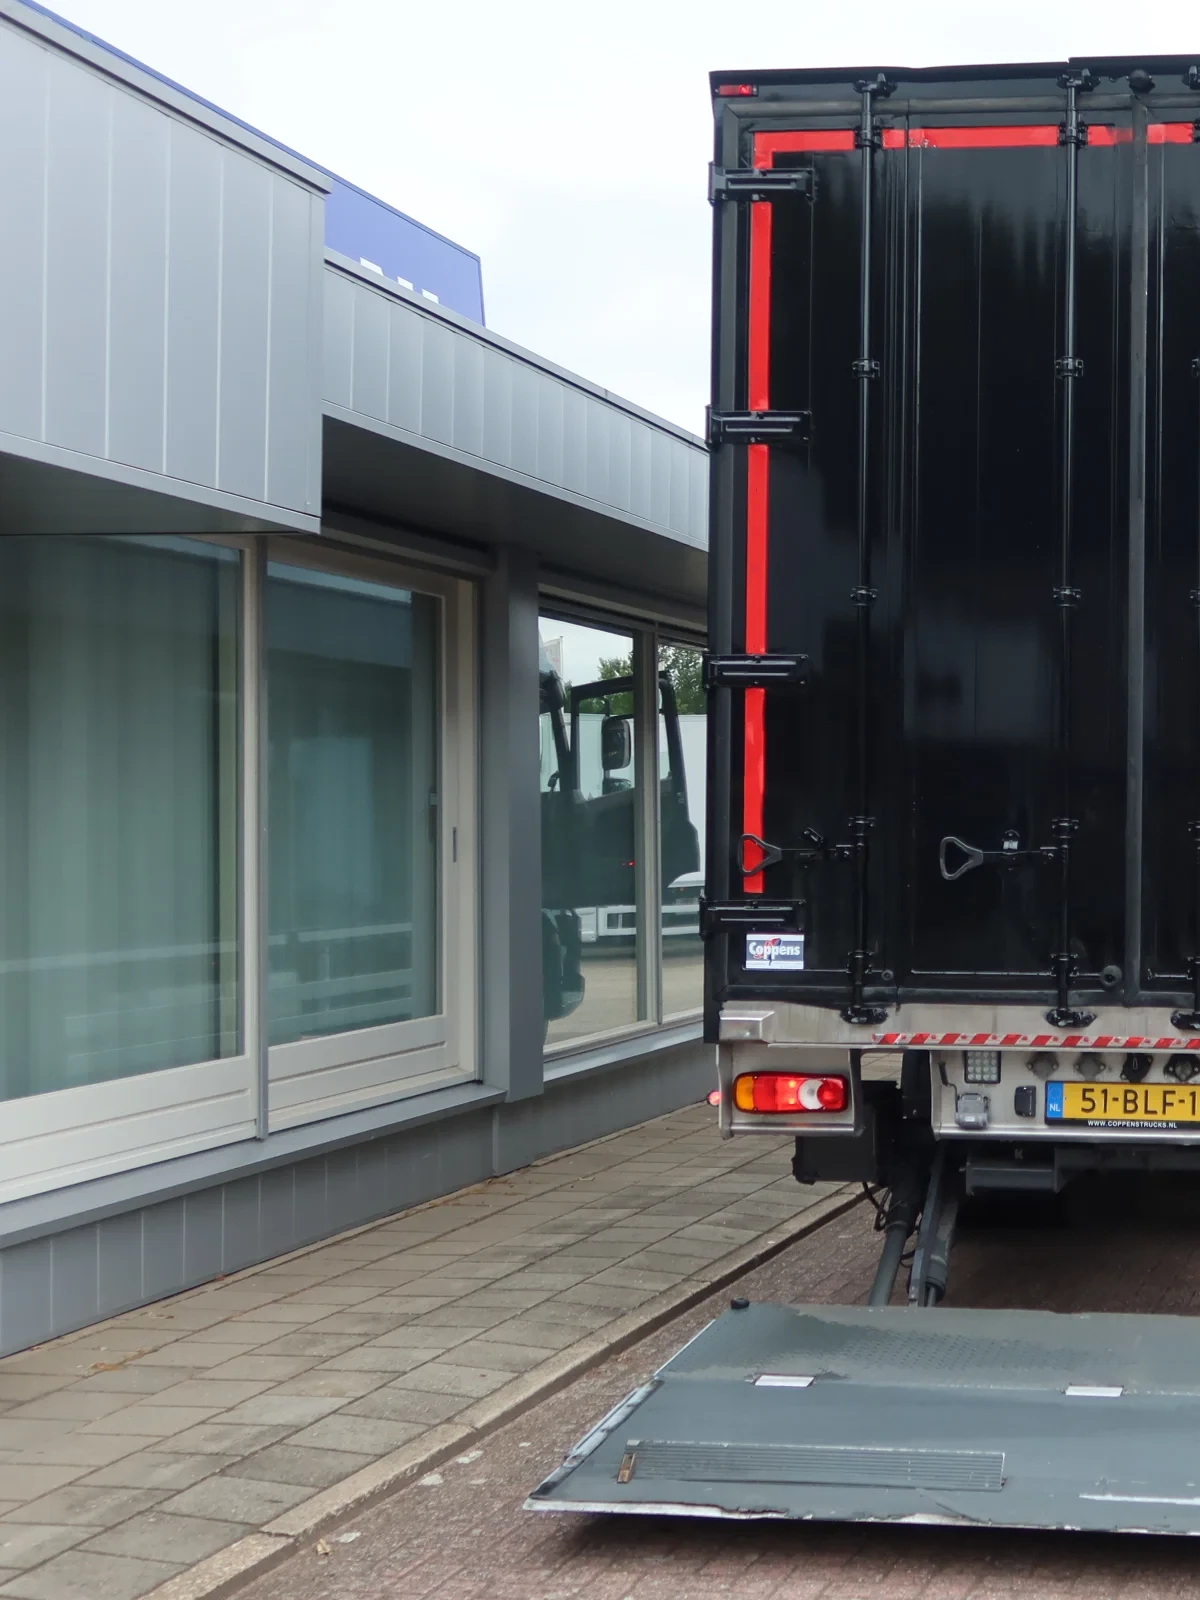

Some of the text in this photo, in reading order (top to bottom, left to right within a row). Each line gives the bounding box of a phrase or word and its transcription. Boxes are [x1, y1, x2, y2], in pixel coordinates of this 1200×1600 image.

[749, 942, 801, 960] Coppens
[1049, 1104, 1061, 1112] NL
[1081, 1088, 1197, 1116] 51-BLF-1
[1087, 1120, 1177, 1129] WWW.COPPENSTRUCKS.NL
